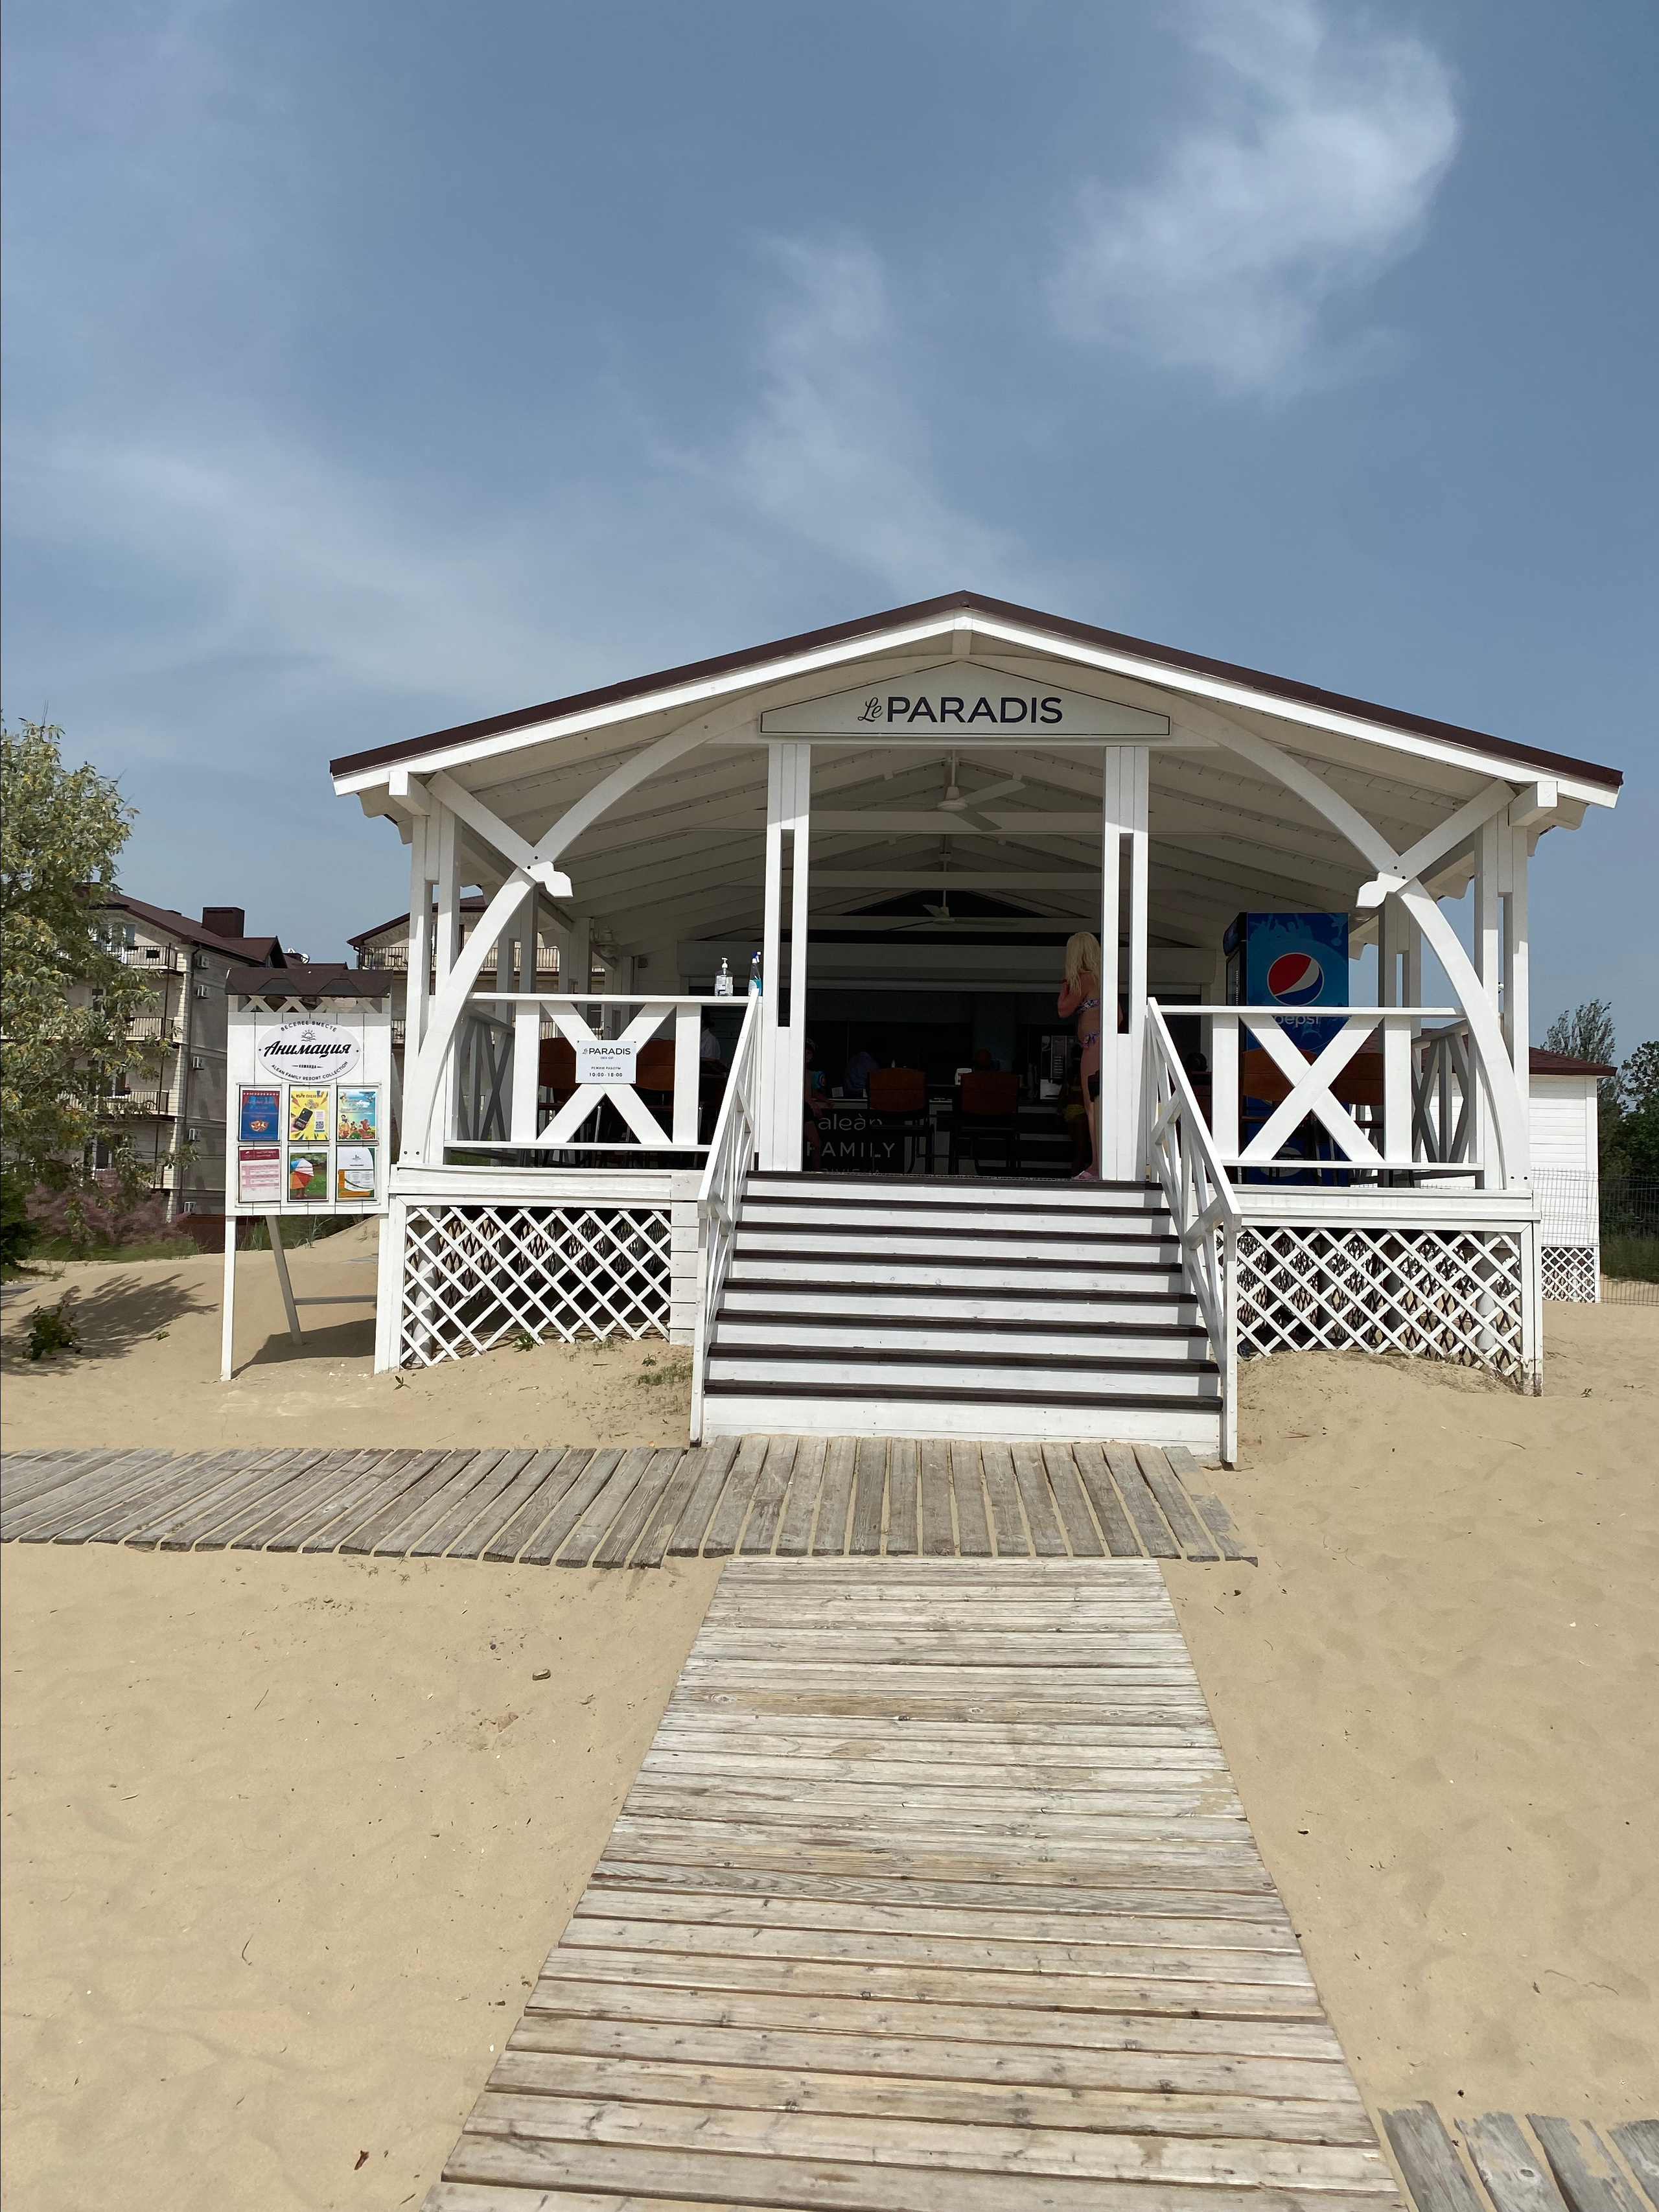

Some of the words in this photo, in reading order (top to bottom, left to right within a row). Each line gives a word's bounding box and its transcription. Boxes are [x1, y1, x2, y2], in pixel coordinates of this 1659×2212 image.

[857, 697, 883, 722] Le
[887, 697, 1063, 723] PARADIS
[281, 1020, 309, 1032] ВЕСЕЛЕЕ
[312, 1020, 337, 1032] ВМЕСТЕ
[264, 1040, 352, 1058] Анимация
[272, 1064, 285, 1075] ALEAN
[285, 1072, 302, 1080] FAMILY
[322, 1061, 349, 1079] COLLECTION
